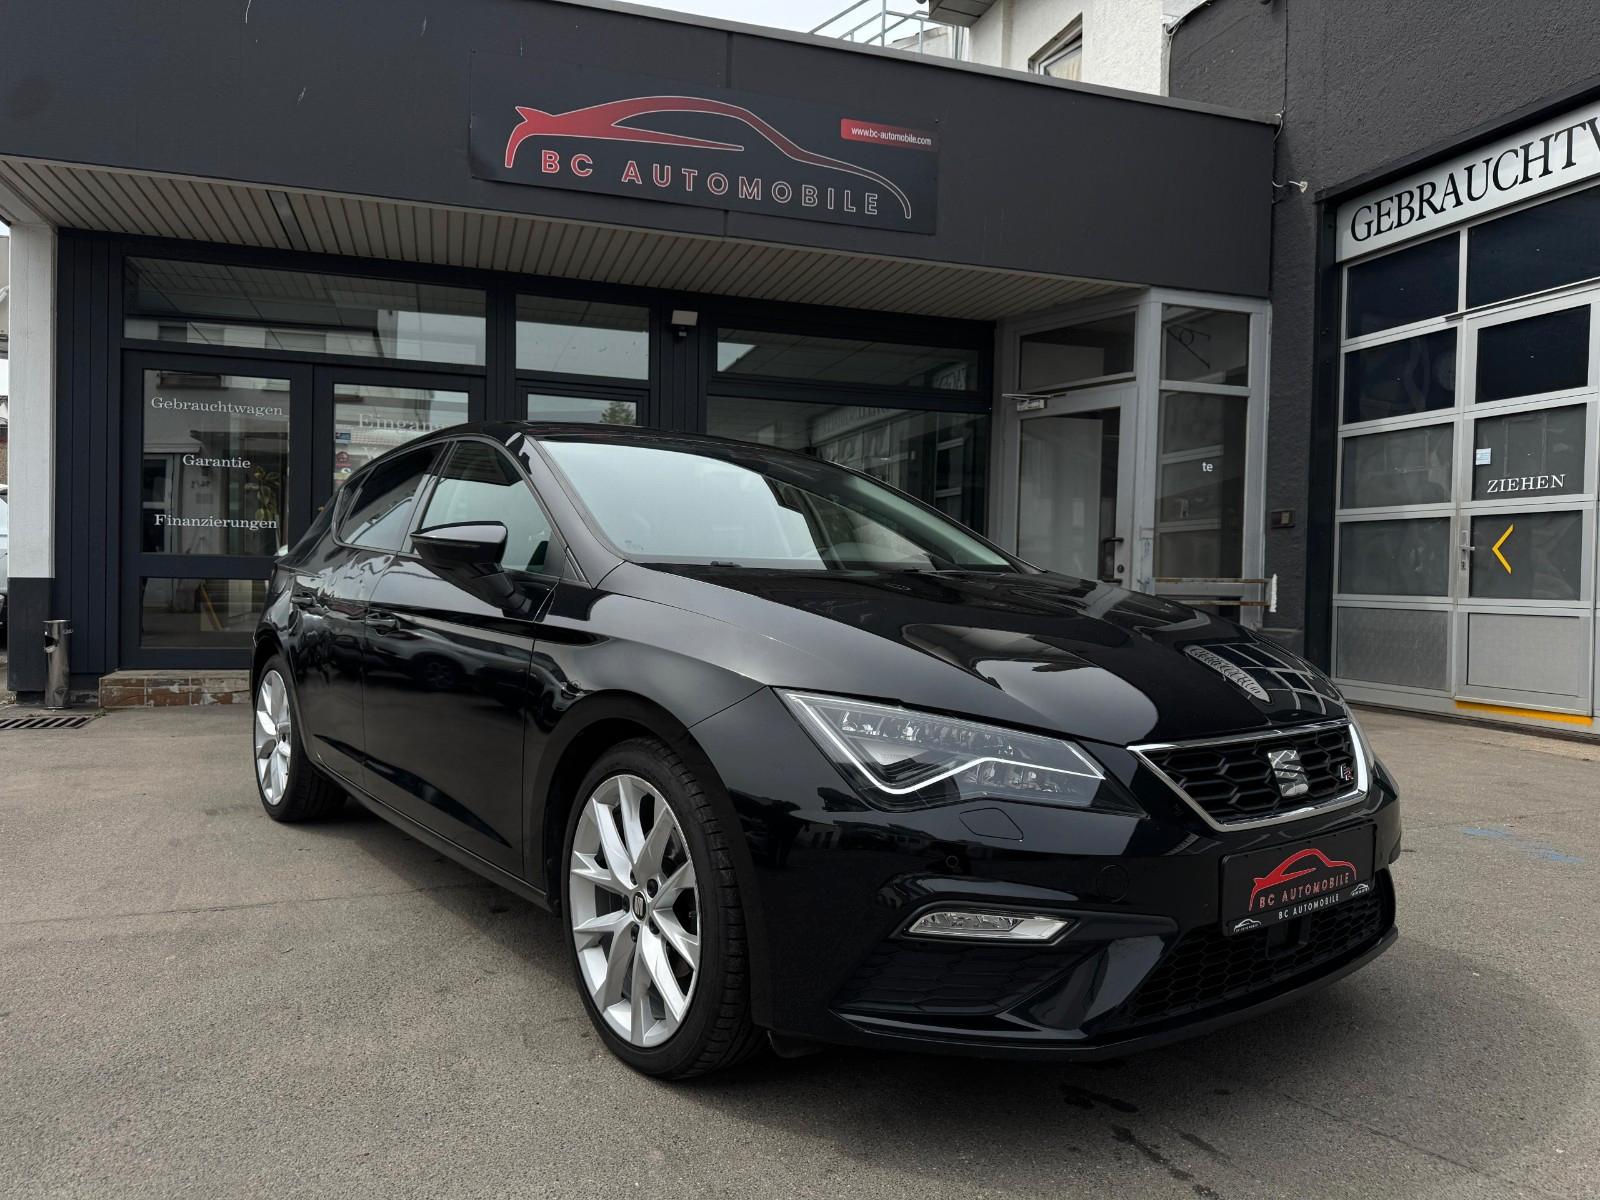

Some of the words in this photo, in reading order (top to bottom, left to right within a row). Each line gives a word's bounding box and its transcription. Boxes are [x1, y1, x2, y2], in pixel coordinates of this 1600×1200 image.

[850, 127, 932, 146] www.bc-automobile.com
[541, 149, 593, 177] BC
[621, 160, 878, 216] AUTOMOBILE
[1350, 117, 1600, 242] GEBRAUCHT
[150, 397, 283, 417] Gebrauchtwagen
[182, 454, 251, 469] Garantie
[1202, 461, 1214, 472] te
[1487, 473, 1567, 493] ZIEHEN
[153, 514, 278, 532] Finanzierungen
[1259, 893, 1275, 909] BC
[1281, 872, 1350, 902] AUTOMOBILE
[1278, 911, 1289, 920] BC
[1293, 893, 1339, 916] AUTOMOBILE
